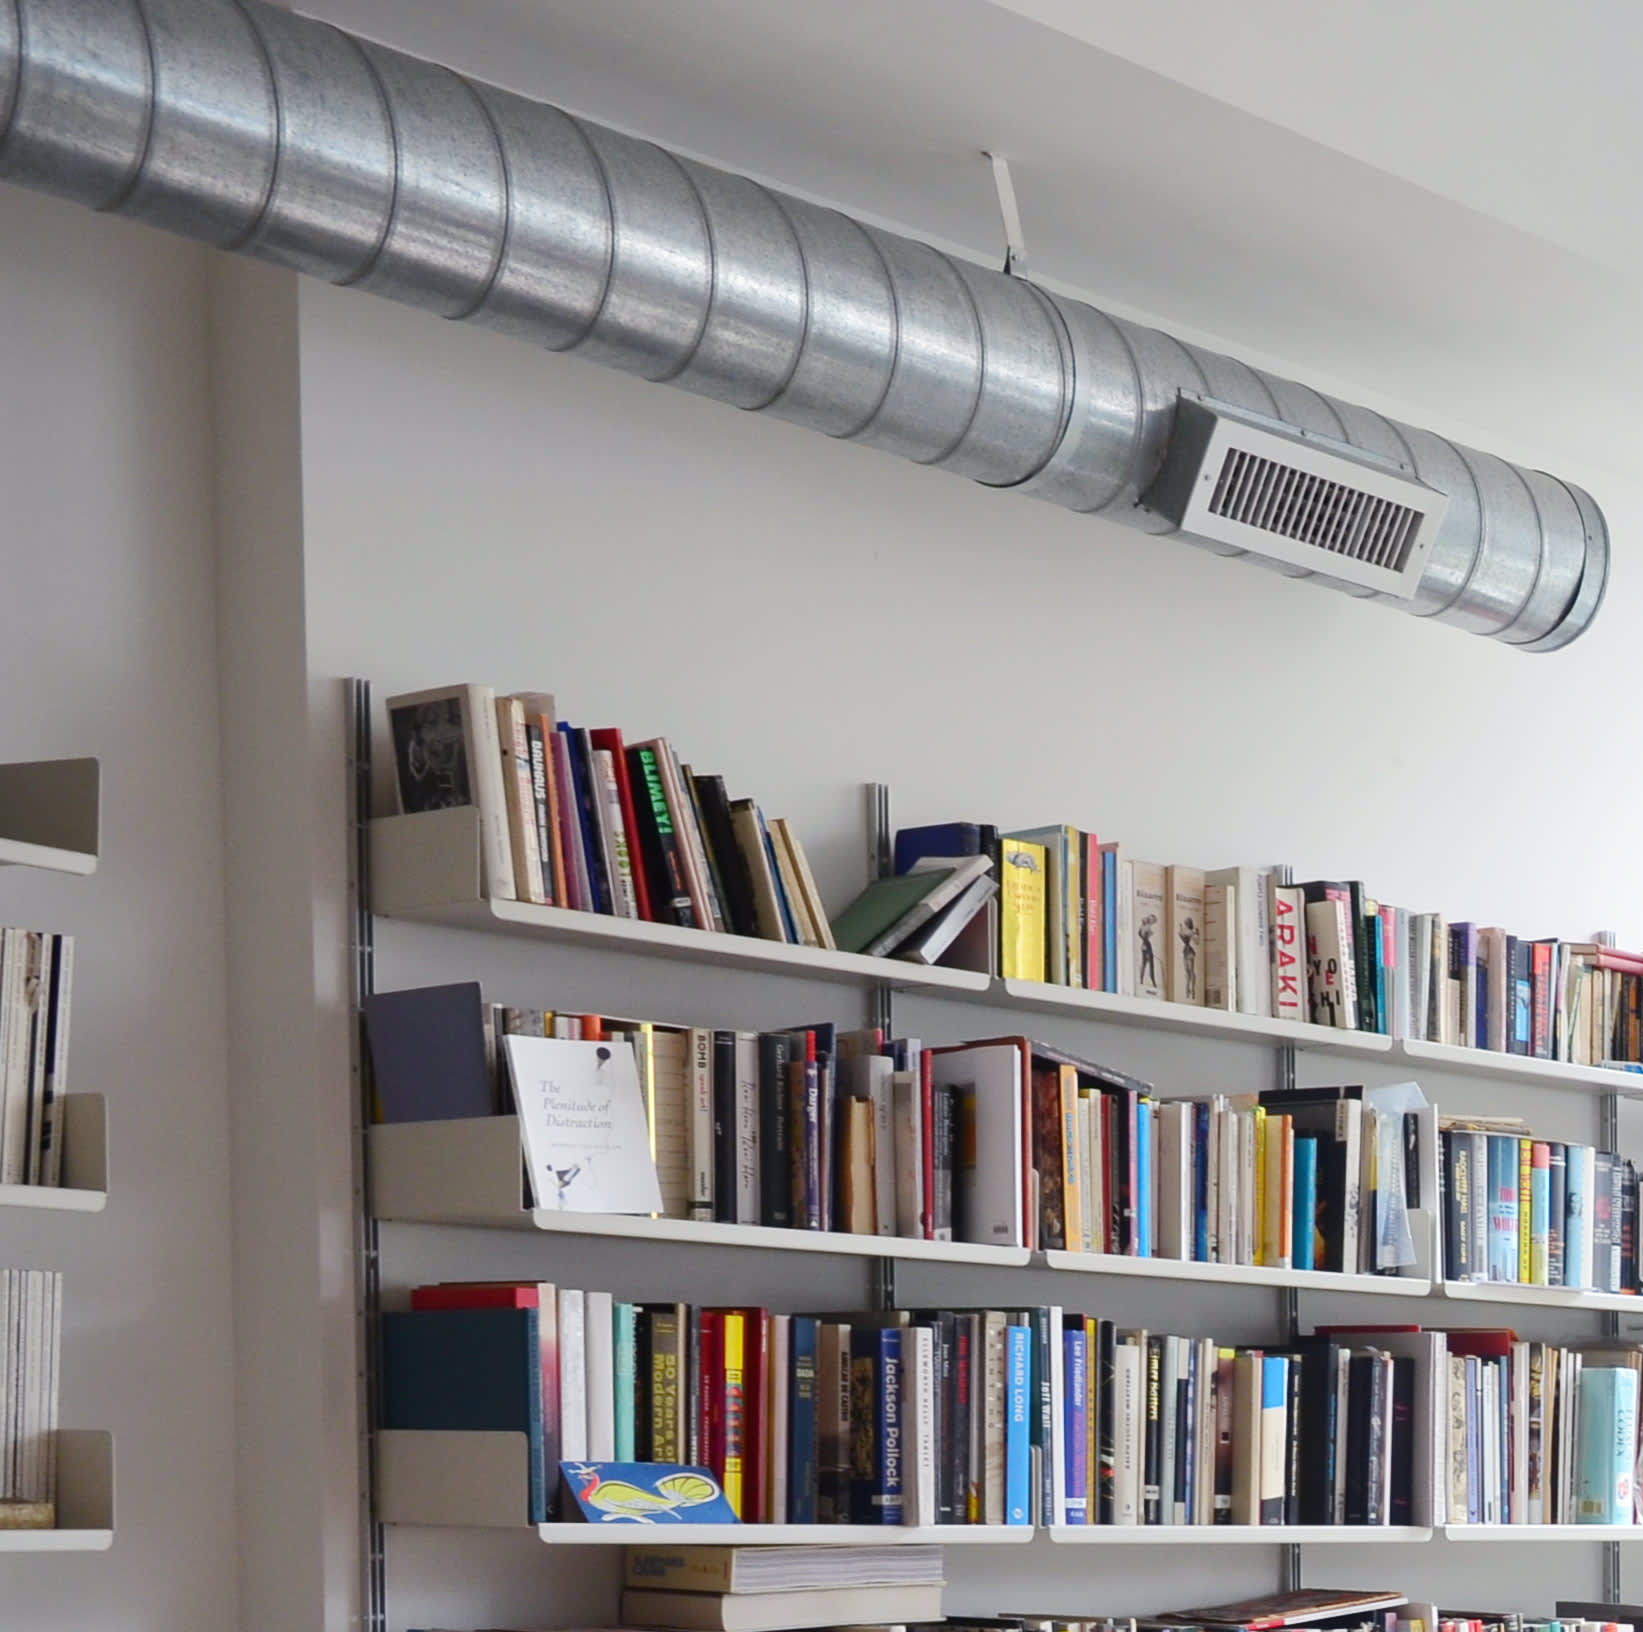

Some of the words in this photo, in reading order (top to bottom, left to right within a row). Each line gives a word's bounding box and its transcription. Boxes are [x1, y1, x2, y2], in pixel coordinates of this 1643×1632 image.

[640, 750, 673, 834] BLIMEY!
[1278, 900, 1298, 1007] ARAKI
[697, 1035, 706, 1069] BOMB
[806, 1088, 818, 1123] Darger
[1014, 1332, 1025, 1386] RICHARD
[1073, 1340, 1082, 1356] Lee
[653, 1353, 665, 1429] Modern
[885, 1357, 899, 1422] Jackson
[1014, 1388, 1025, 1423] LONG
[1073, 1358, 1083, 1406] Friedlander
[664, 1384, 676, 1435] Years
[885, 1427, 900, 1487] Pollock
